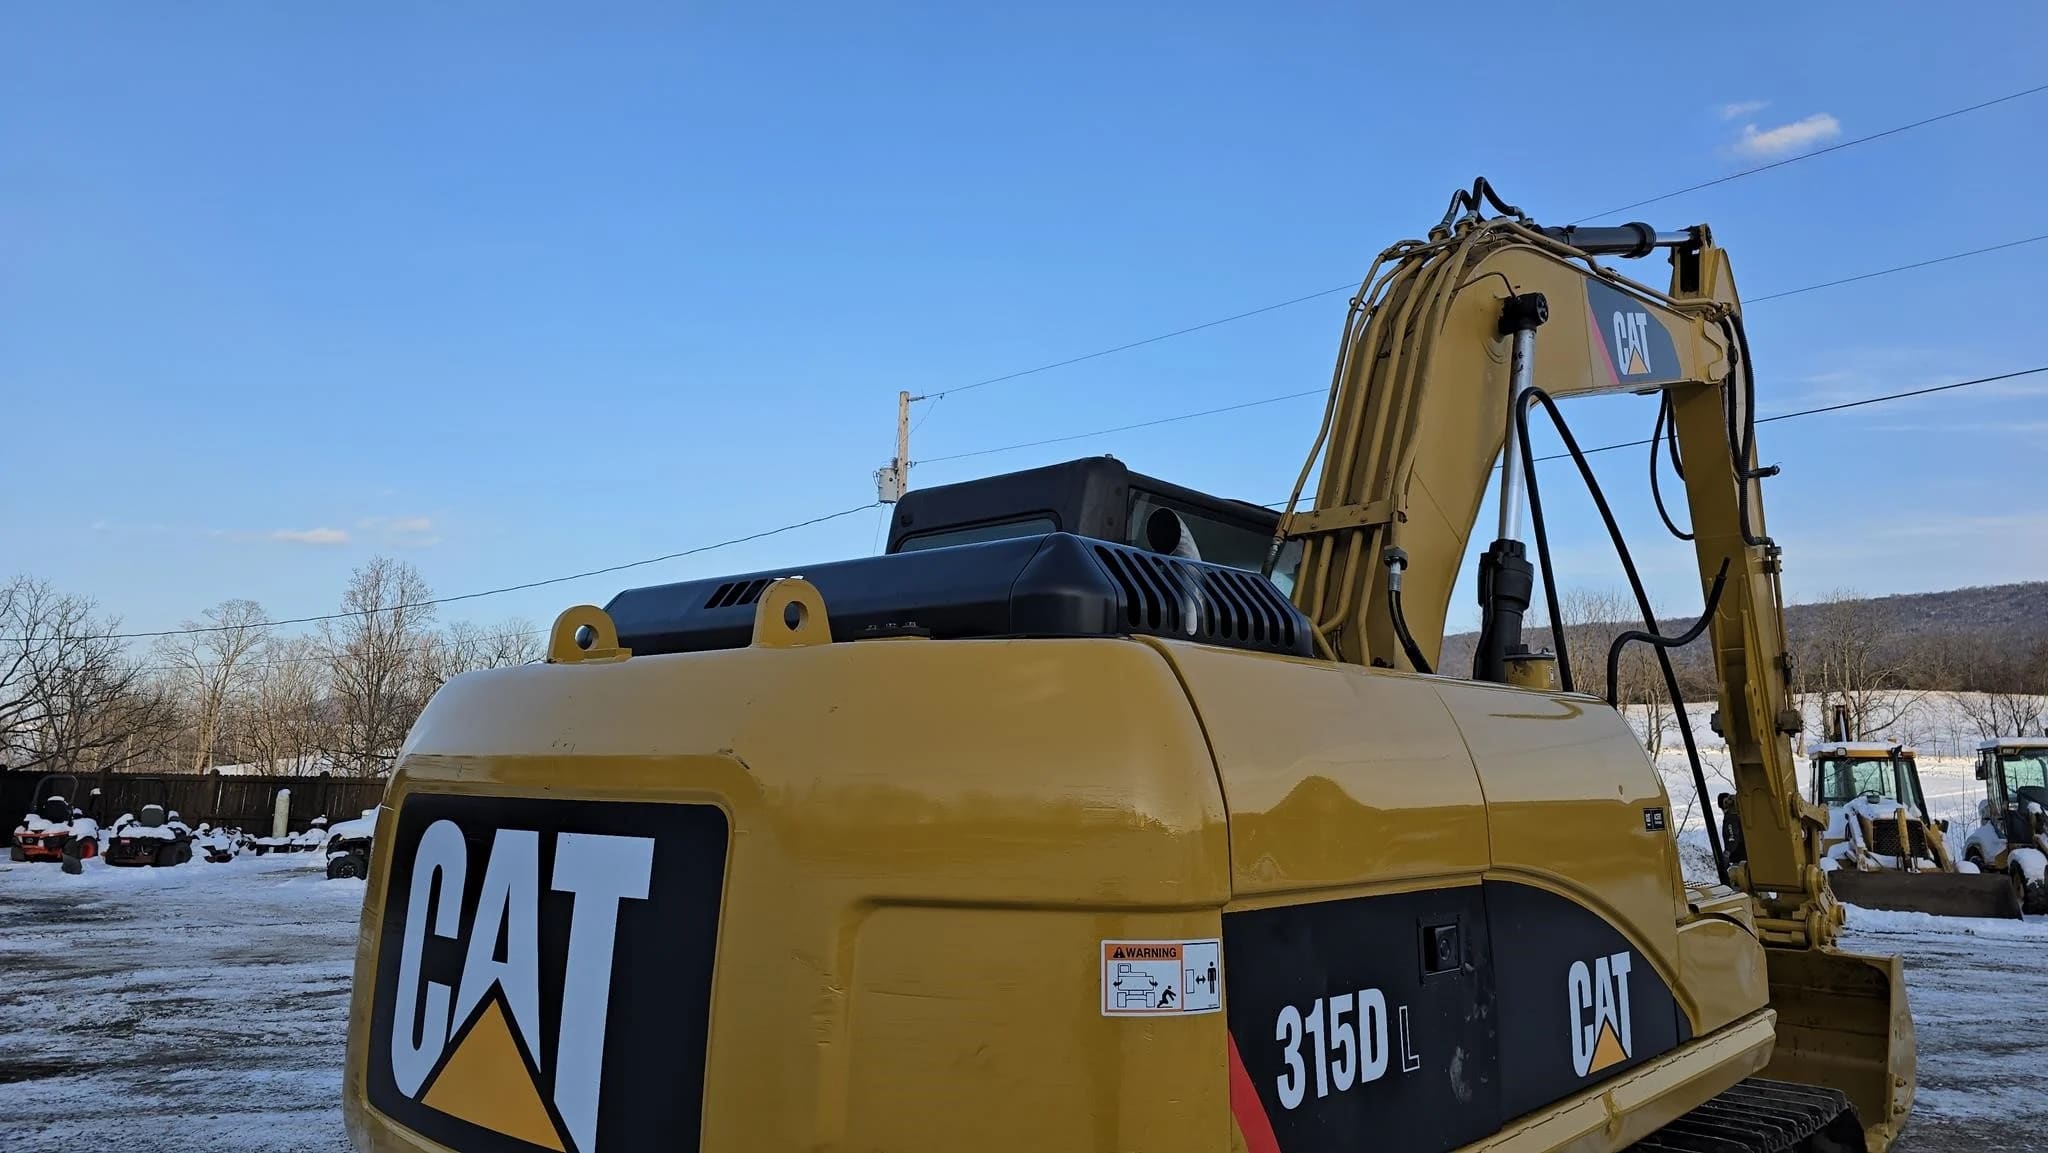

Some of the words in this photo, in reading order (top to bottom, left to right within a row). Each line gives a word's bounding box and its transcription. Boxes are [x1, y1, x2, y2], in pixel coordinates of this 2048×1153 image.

[1613, 311, 1651, 375] CAT
[391, 819, 656, 1153] CAT
[1126, 947, 1177, 958] WARNING
[1276, 988, 1389, 1110] 315D
[1399, 1005, 1420, 1073] L
[1568, 951, 1632, 1077] CAT
